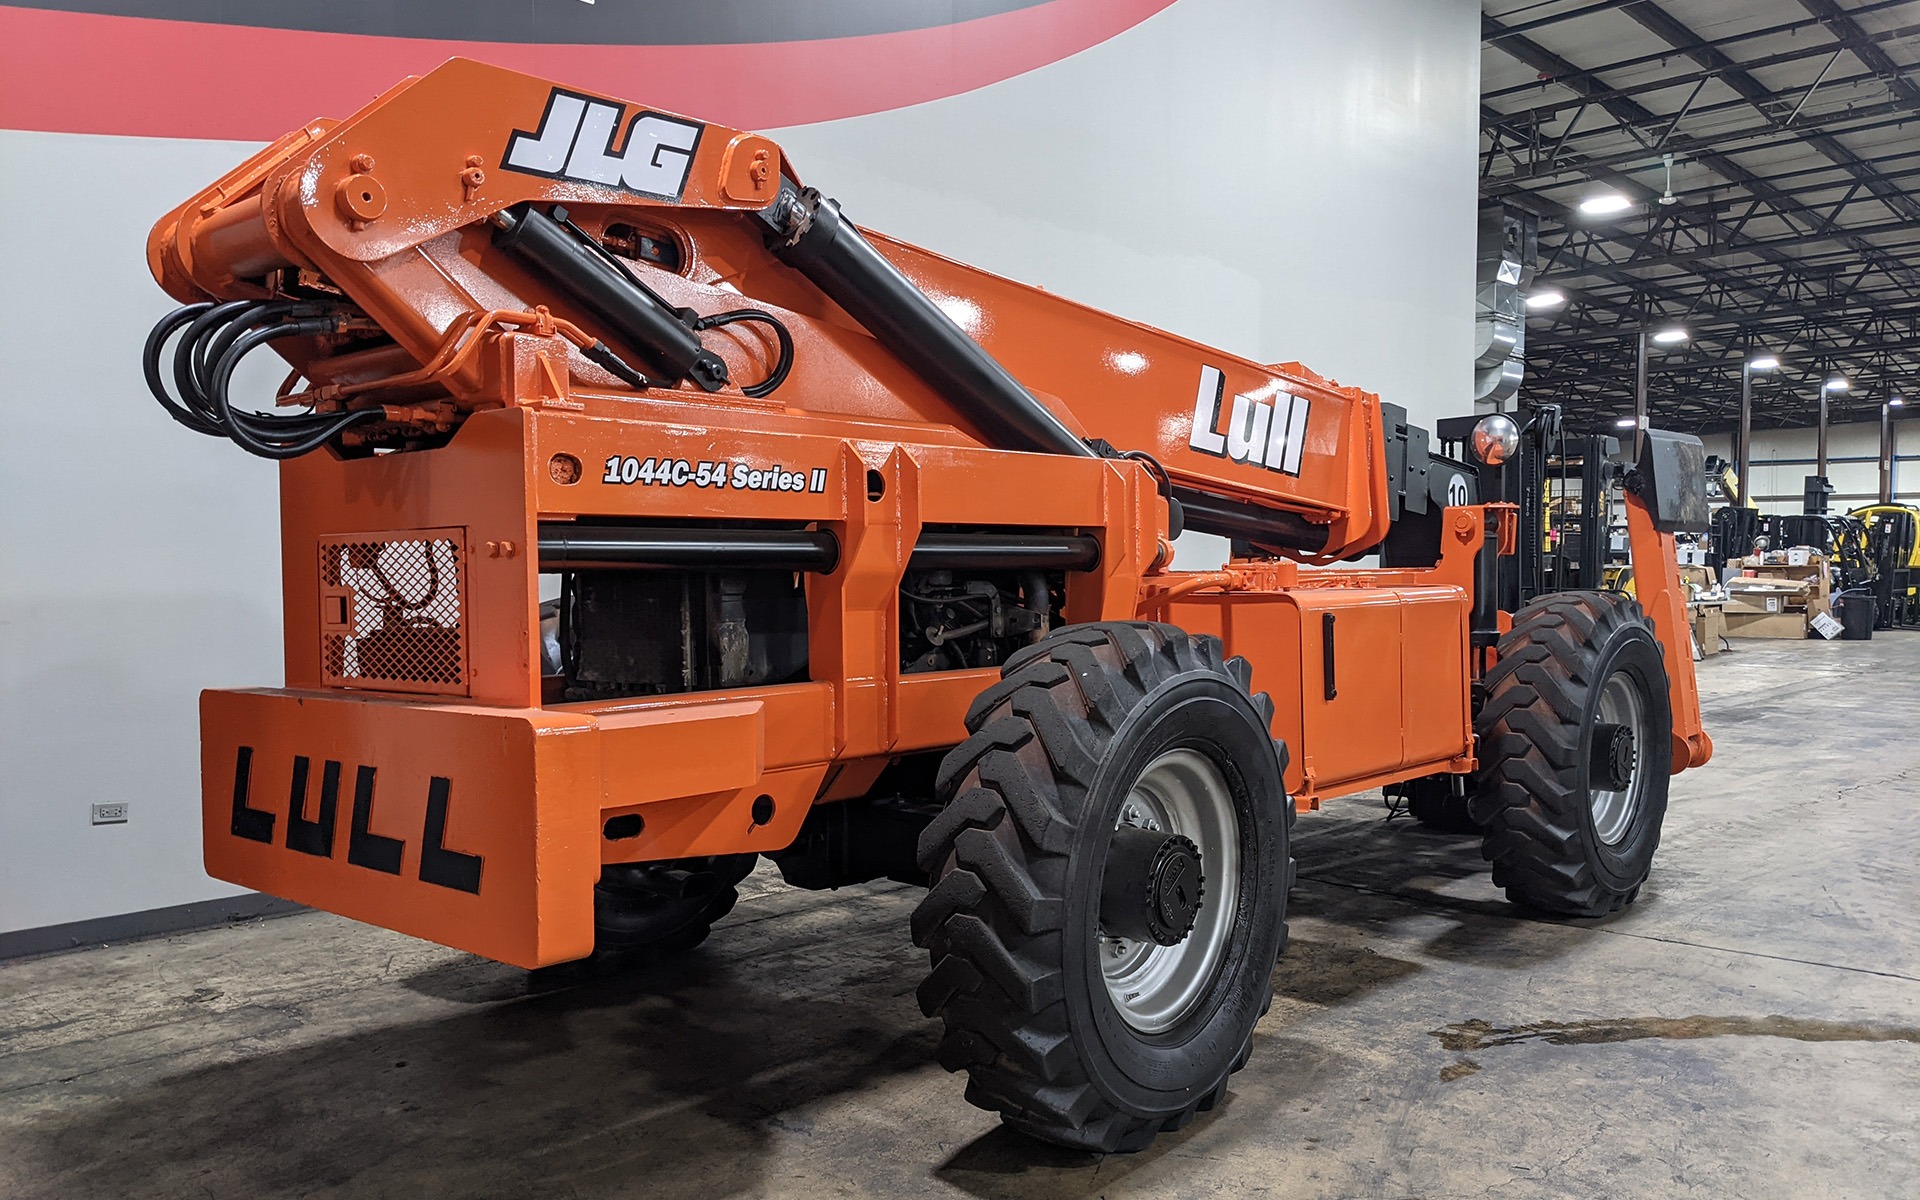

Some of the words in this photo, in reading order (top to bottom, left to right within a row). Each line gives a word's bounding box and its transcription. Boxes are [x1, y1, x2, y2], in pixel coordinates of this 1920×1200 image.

[505, 92, 702, 199] JLG
[1189, 363, 1310, 477] Lull
[602, 456, 726, 488] 1044C-54
[731, 465, 805, 491] Series
[809, 469, 827, 492] II
[1449, 483, 1466, 506] 10
[231, 746, 484, 896] LULL
